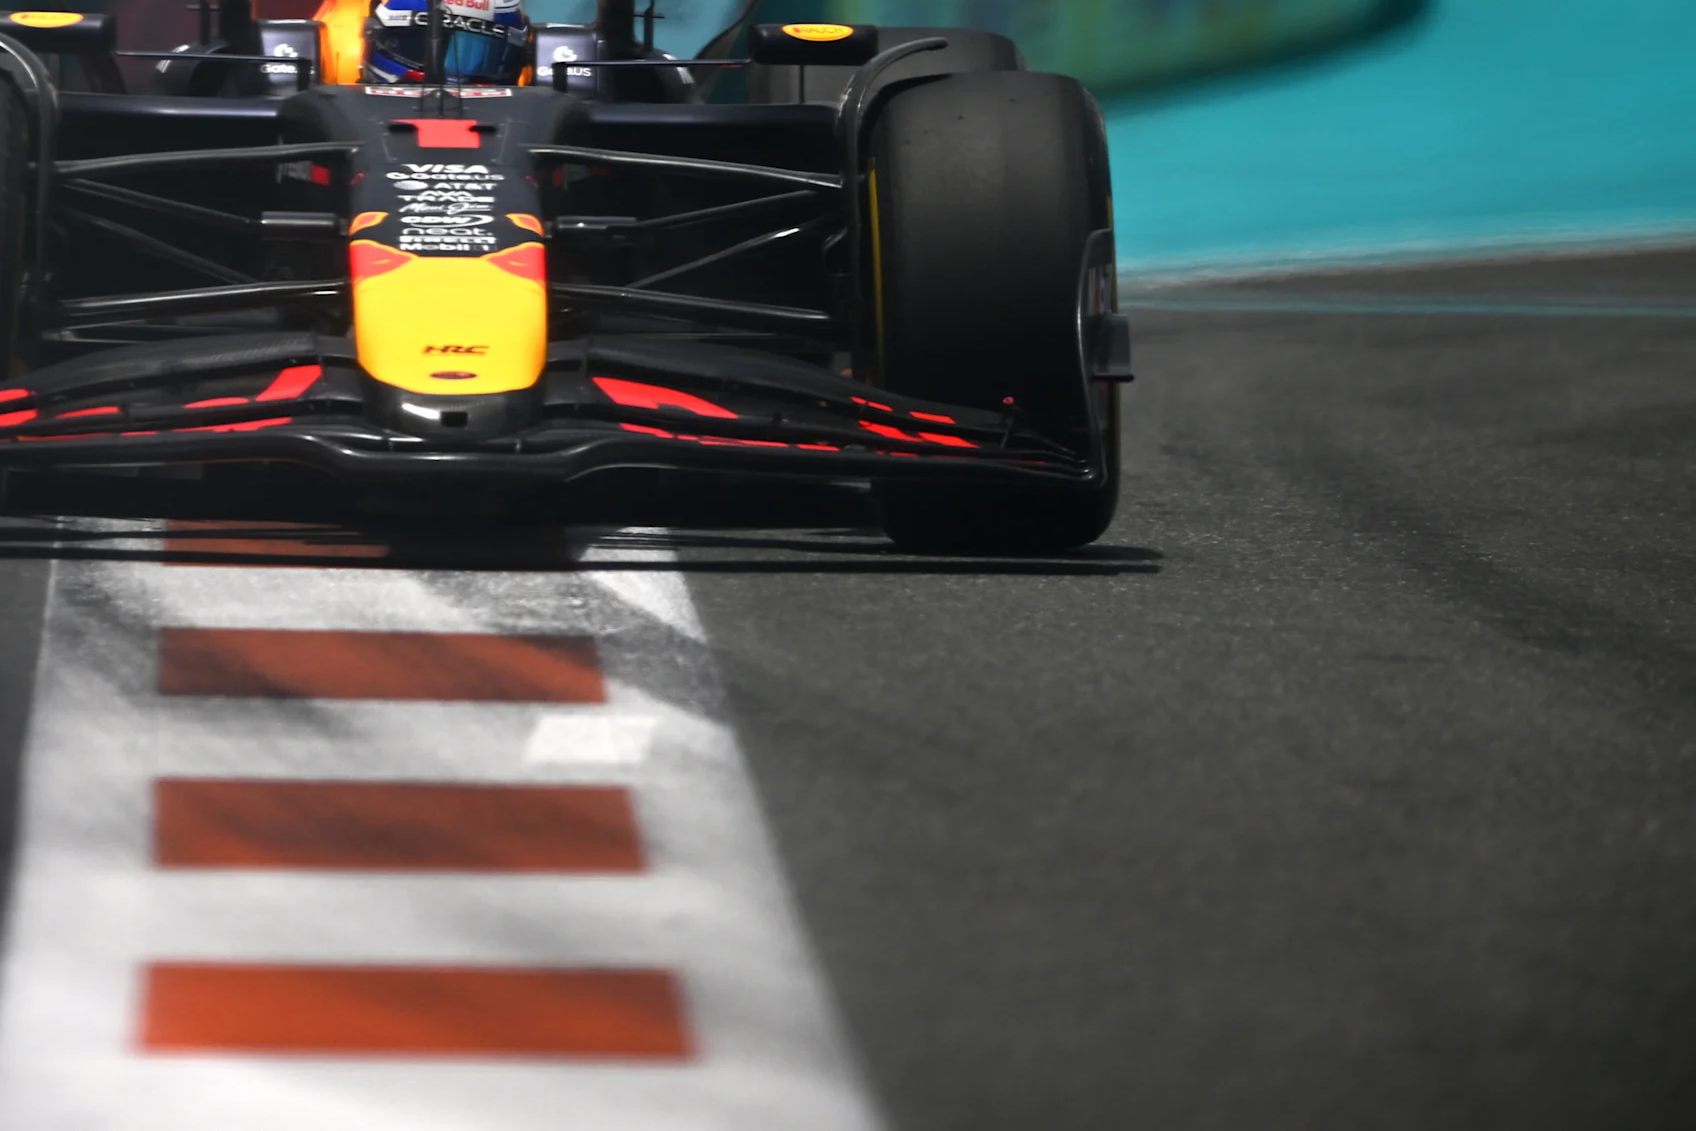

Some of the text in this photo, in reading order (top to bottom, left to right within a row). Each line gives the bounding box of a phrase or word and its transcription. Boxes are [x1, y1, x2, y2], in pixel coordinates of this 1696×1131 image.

[401, 163, 489, 174] VISA
[434, 182, 499, 191] AT&T
[422, 345, 490, 356] HRC
